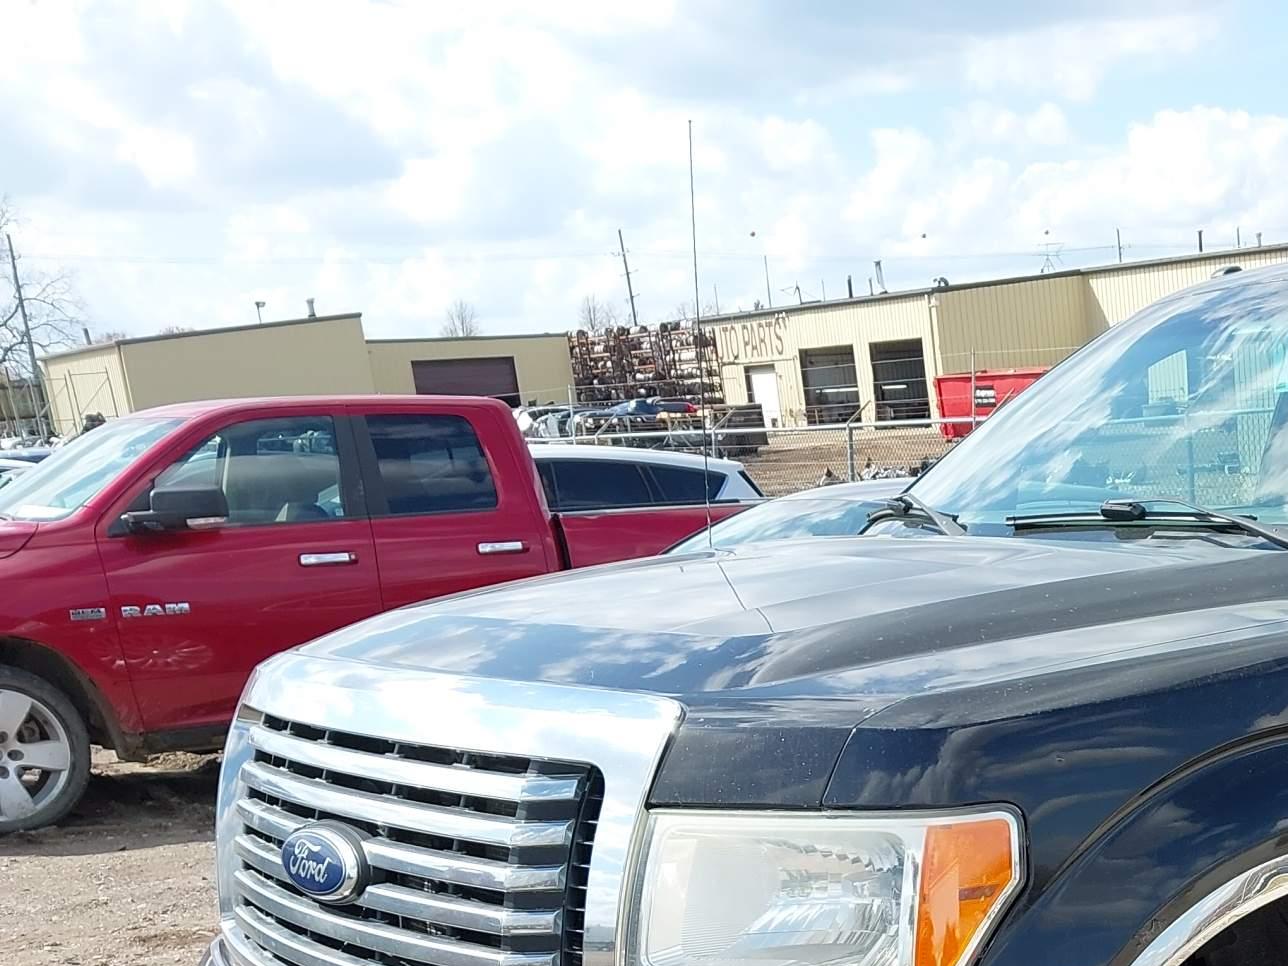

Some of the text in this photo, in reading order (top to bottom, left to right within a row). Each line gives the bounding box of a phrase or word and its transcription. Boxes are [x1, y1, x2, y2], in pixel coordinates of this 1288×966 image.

[741, 318, 785, 358] PARTS
[121, 602, 190, 618] RAM
[289, 838, 336, 884] Ford
